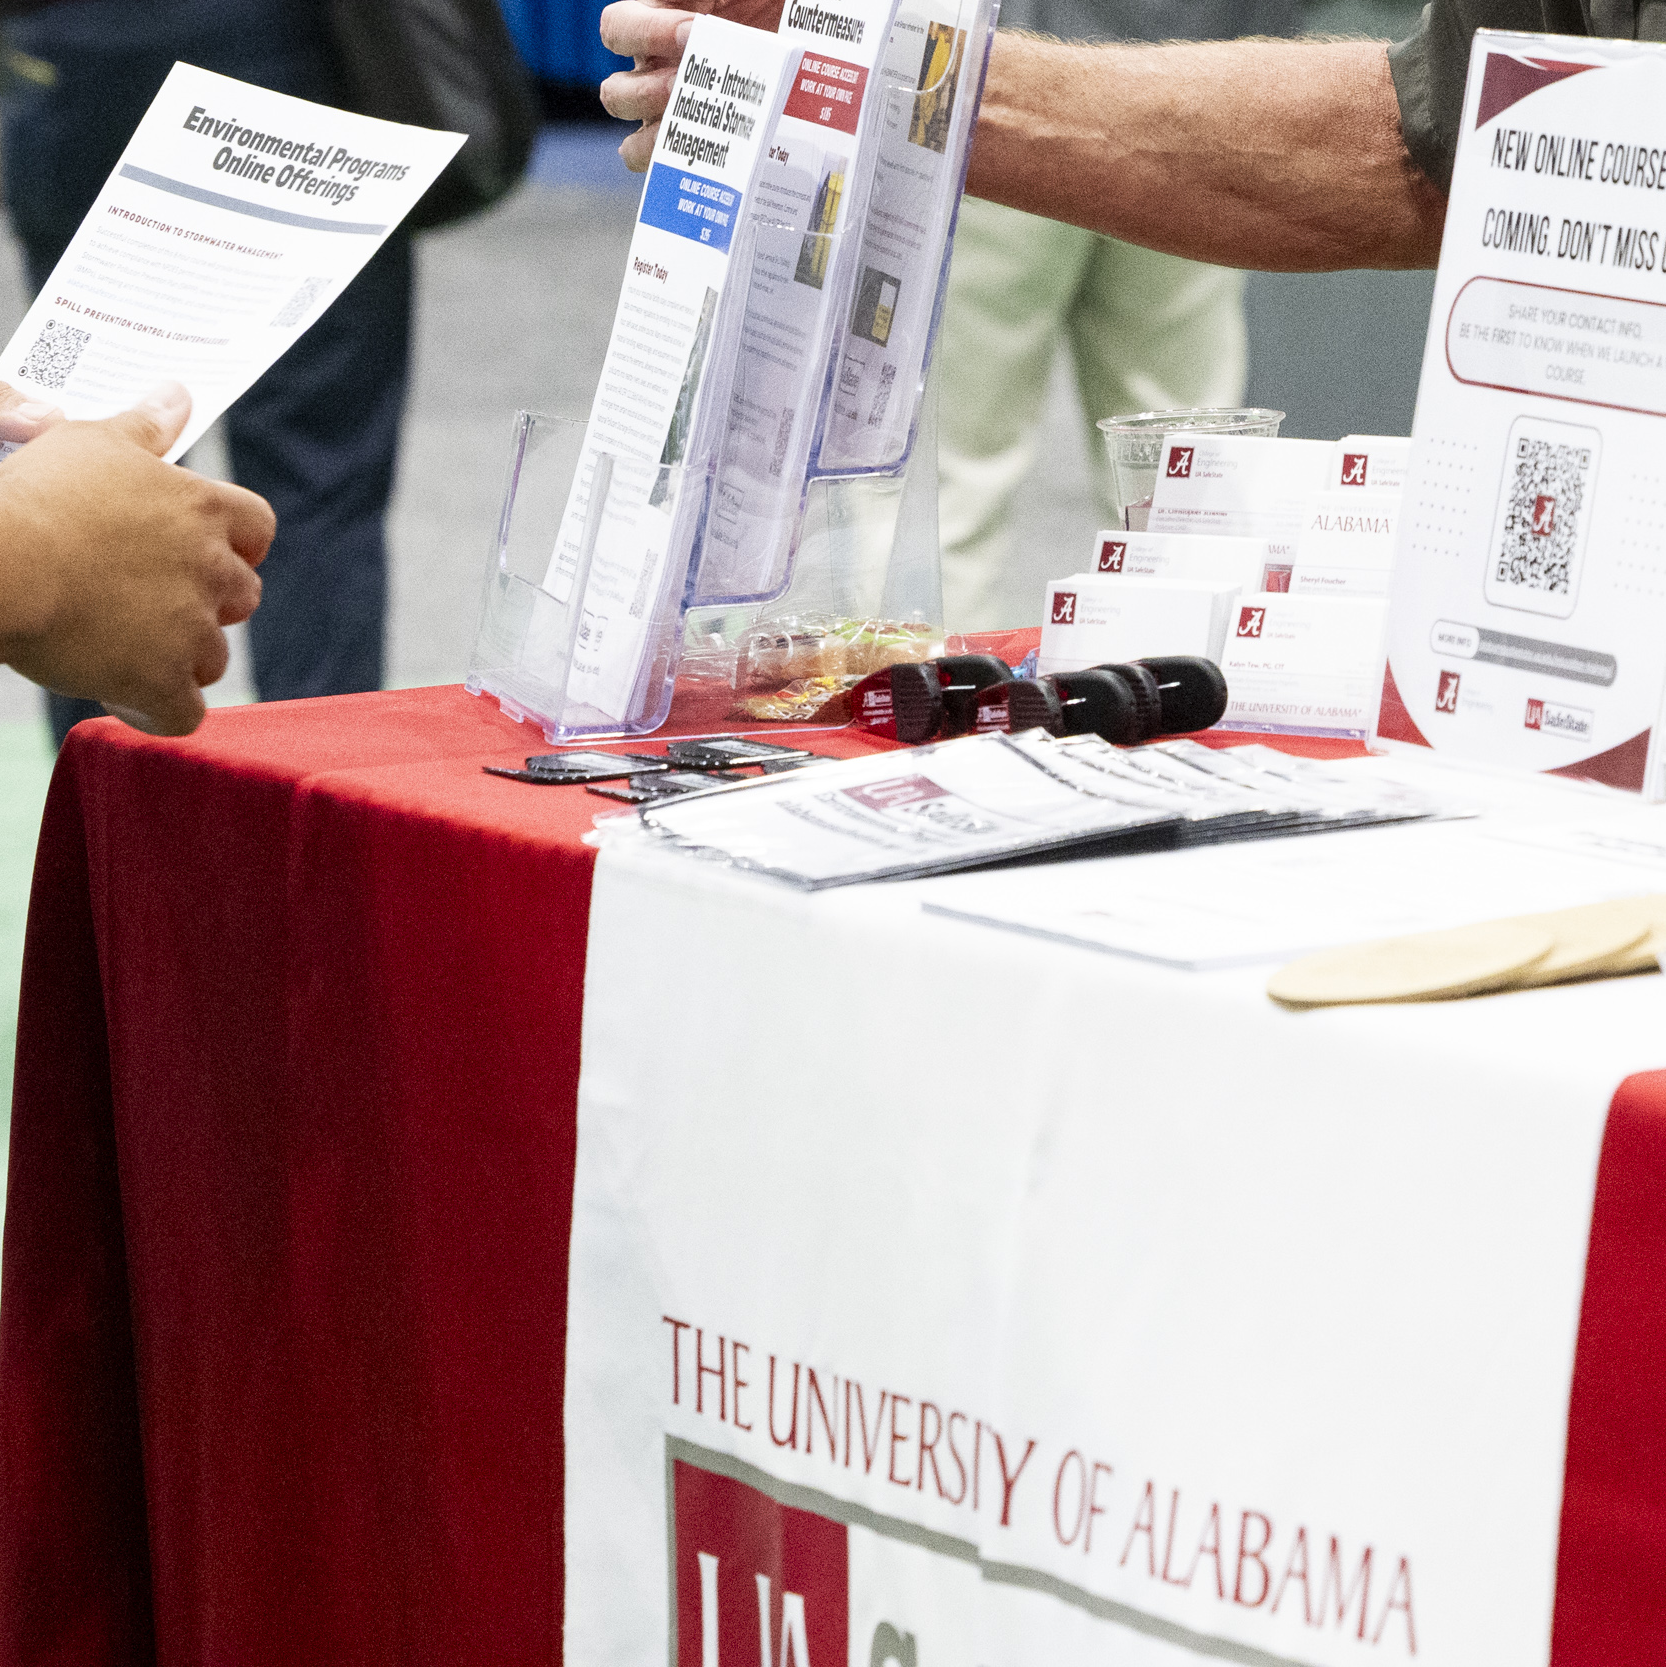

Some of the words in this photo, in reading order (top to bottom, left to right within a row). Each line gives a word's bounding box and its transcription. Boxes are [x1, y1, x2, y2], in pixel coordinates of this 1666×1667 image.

[683, 53, 718, 91] Online
[801, 57, 823, 75] ONLINE
[820, 62, 842, 80] COURSE
[799, 78, 818, 94] WORK
[815, 82, 824, 96] AT
[822, 84, 838, 100] YOUR
[672, 87, 727, 130] Industrial
[182, 105, 334, 171] Environmental
[326, 147, 411, 183] Programs
[662, 120, 731, 169] Management
[775, 145, 790, 167] Today
[1490, 128, 1534, 171] NEW
[1534, 134, 1599, 182] ONLINE
[212, 146, 276, 184] Online
[275, 164, 360, 206] Offerings
[679, 176, 702, 195] ONLINE
[699, 183, 722, 202] COURSE
[677, 197, 697, 215] WORK
[693, 203, 705, 217] AT
[107, 204, 172, 234] INTRODUCTION
[172, 227, 183, 237] TO
[183, 230, 236, 252] STORMWATER
[235, 243, 284, 260] MANAGEMENT
[1482, 207, 1552, 257] COMING.
[1557, 218, 1613, 265] DON'T
[1613, 226, 1660, 272] MISS
[633, 256, 654, 276] Register
[653, 263, 670, 284] Today
[54, 295, 82, 314] SPILL
[83, 307, 133, 329] PREVENTION
[132, 321, 166, 339] CONTROL
[1508, 303, 1539, 323] SHARE
[1541, 308, 1567, 326] YOUR
[1568, 313, 1617, 333] CONTACT
[1459, 322, 1473, 338] BE
[1474, 325, 1490, 342] THE
[1492, 328, 1517, 345] FIRST
[1519, 332, 1533, 349] TO
[1534, 335, 1566, 353] KNOW
[1566, 340, 1596, 358] WHEN
[1597, 345, 1613, 362] WE
[1613, 348, 1654, 368] LAUNCH
[1655, 355, 1663, 368] A
[1196, 458, 1238, 470] Engineering
[1371, 465, 1409, 477] Engineerin
[1310, 514, 1391, 534] ALABAMA
[1129, 552, 1170, 566] Engineering
[1300, 575, 1321, 584] Sheryl
[1080, 603, 1121, 616] Engineering
[1268, 617, 1312, 632] Engineering
[1230, 700, 1247, 713] THE
[1248, 702, 1300, 717] UNIVERSITY
[1300, 704, 1313, 716] OF
[662, 1315, 753, 1432] THE
[769, 1355, 1038, 1528] UNIVERSIY
[1052, 1446, 1115, 1553] OF
[1120, 1480, 1419, 1657] ALABAMA
